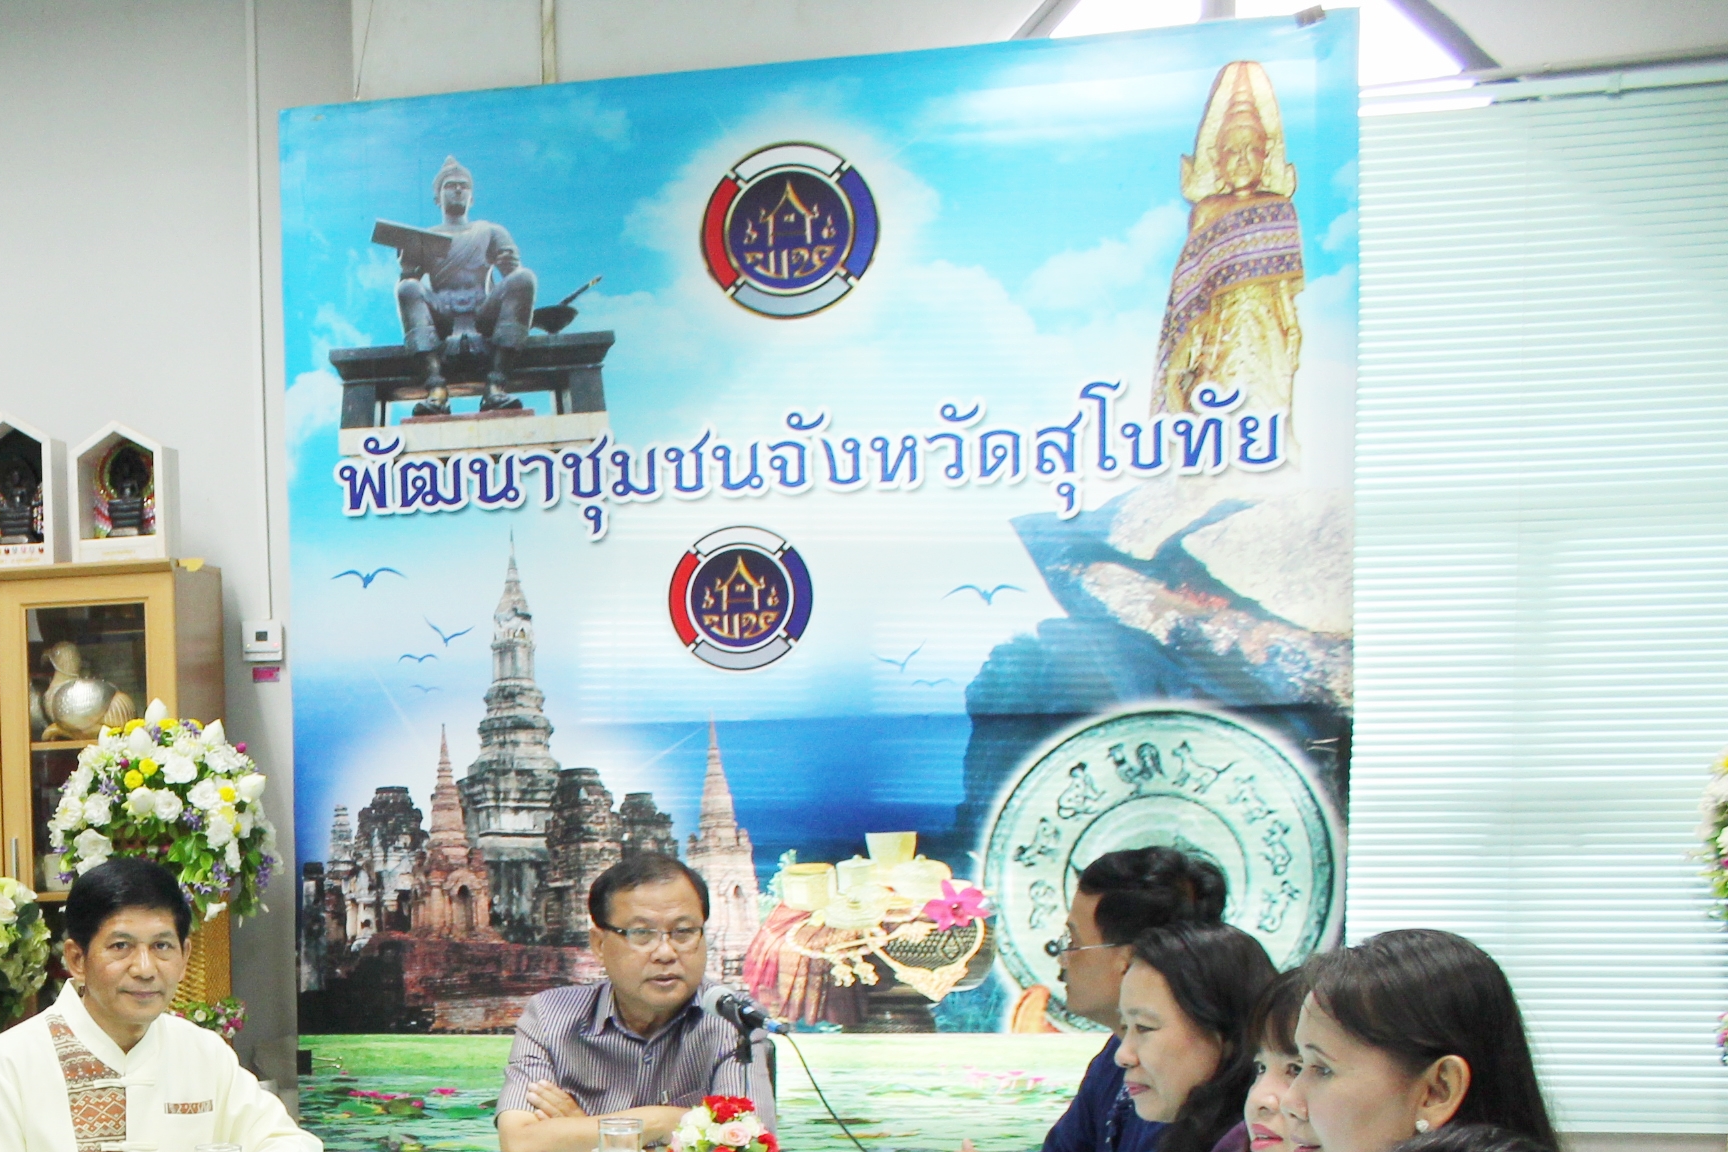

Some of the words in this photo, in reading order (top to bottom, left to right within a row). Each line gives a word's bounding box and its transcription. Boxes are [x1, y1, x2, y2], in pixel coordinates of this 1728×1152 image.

[338, 381, 1278, 535] พัฒนาชุมชนจังหวัดสุโขทัย
